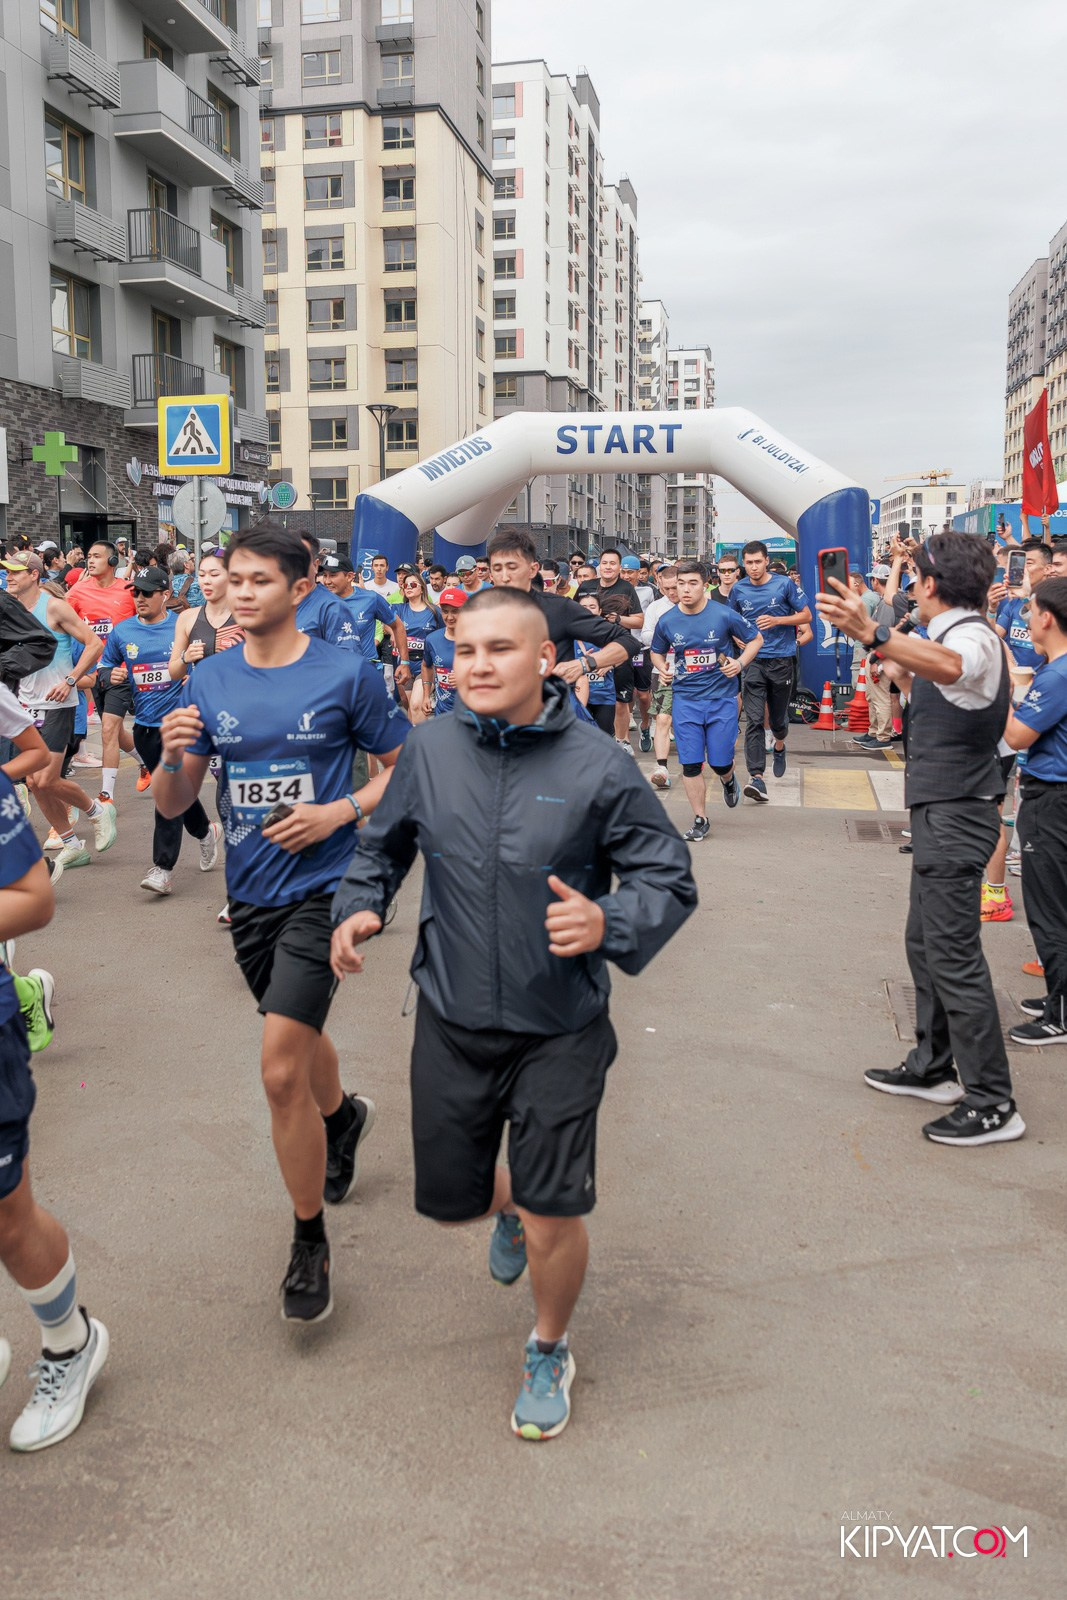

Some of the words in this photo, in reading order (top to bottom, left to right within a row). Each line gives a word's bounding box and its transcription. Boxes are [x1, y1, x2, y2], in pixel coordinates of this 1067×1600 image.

[556, 424, 683, 454] START
[418, 436, 492, 481] INVICTUS
[752, 435, 768, 446] BI
[761, 443, 810, 474] JULDYZAI
[361, 552, 375, 581] City
[692, 655, 710, 664] 301
[142, 672, 163, 683] 188
[587, 673, 600, 681] 07
[238, 778, 302, 804] 1834
